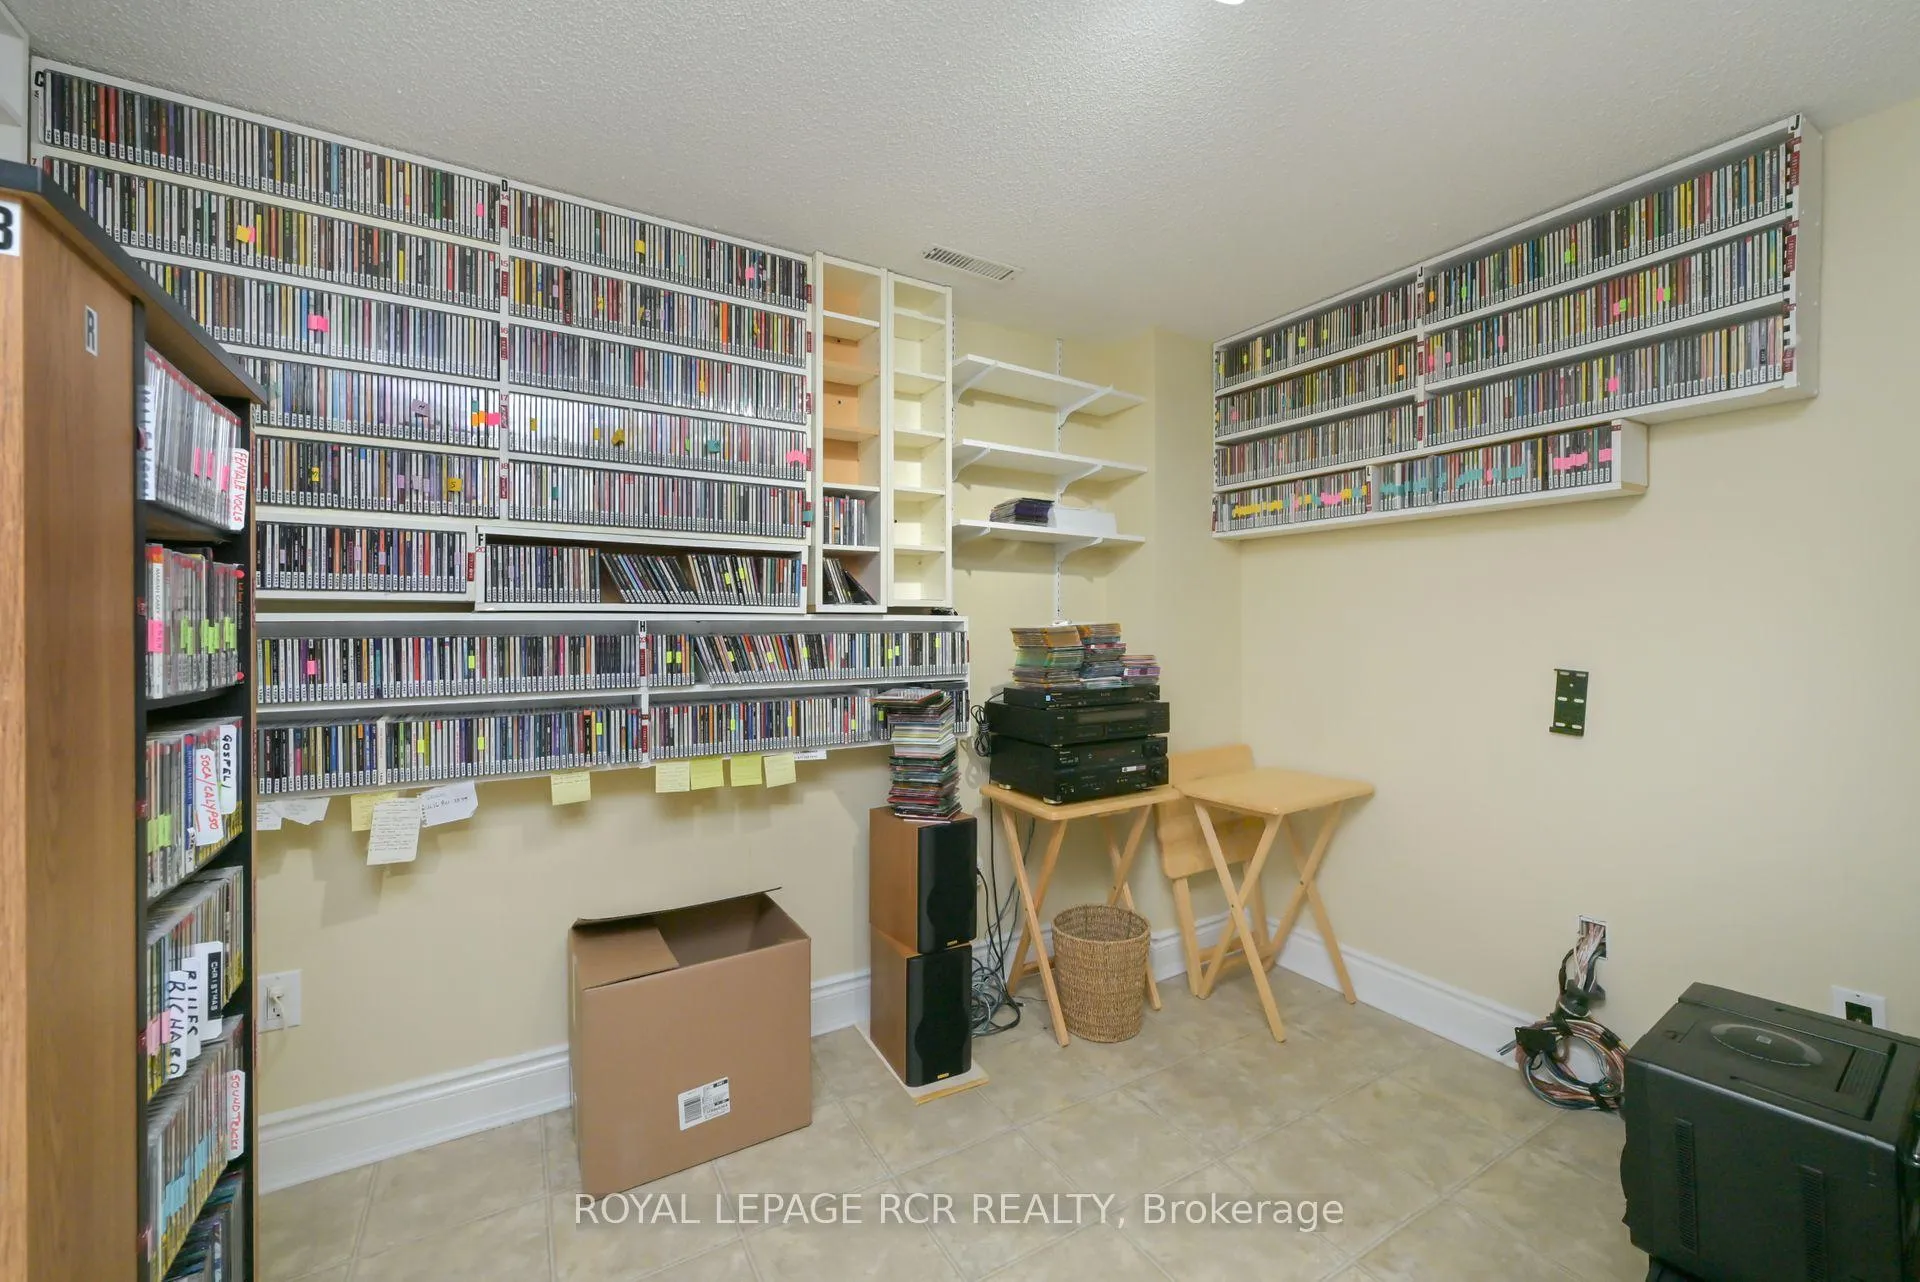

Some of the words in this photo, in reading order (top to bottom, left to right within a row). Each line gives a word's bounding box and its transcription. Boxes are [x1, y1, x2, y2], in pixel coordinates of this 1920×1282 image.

[86, 312, 95, 350] R
[478, 534, 484, 546] F
[640, 621, 646, 632] H
[210, 961, 218, 1011] CHRISTMAS
[168, 979, 186, 1075] RICHARD
